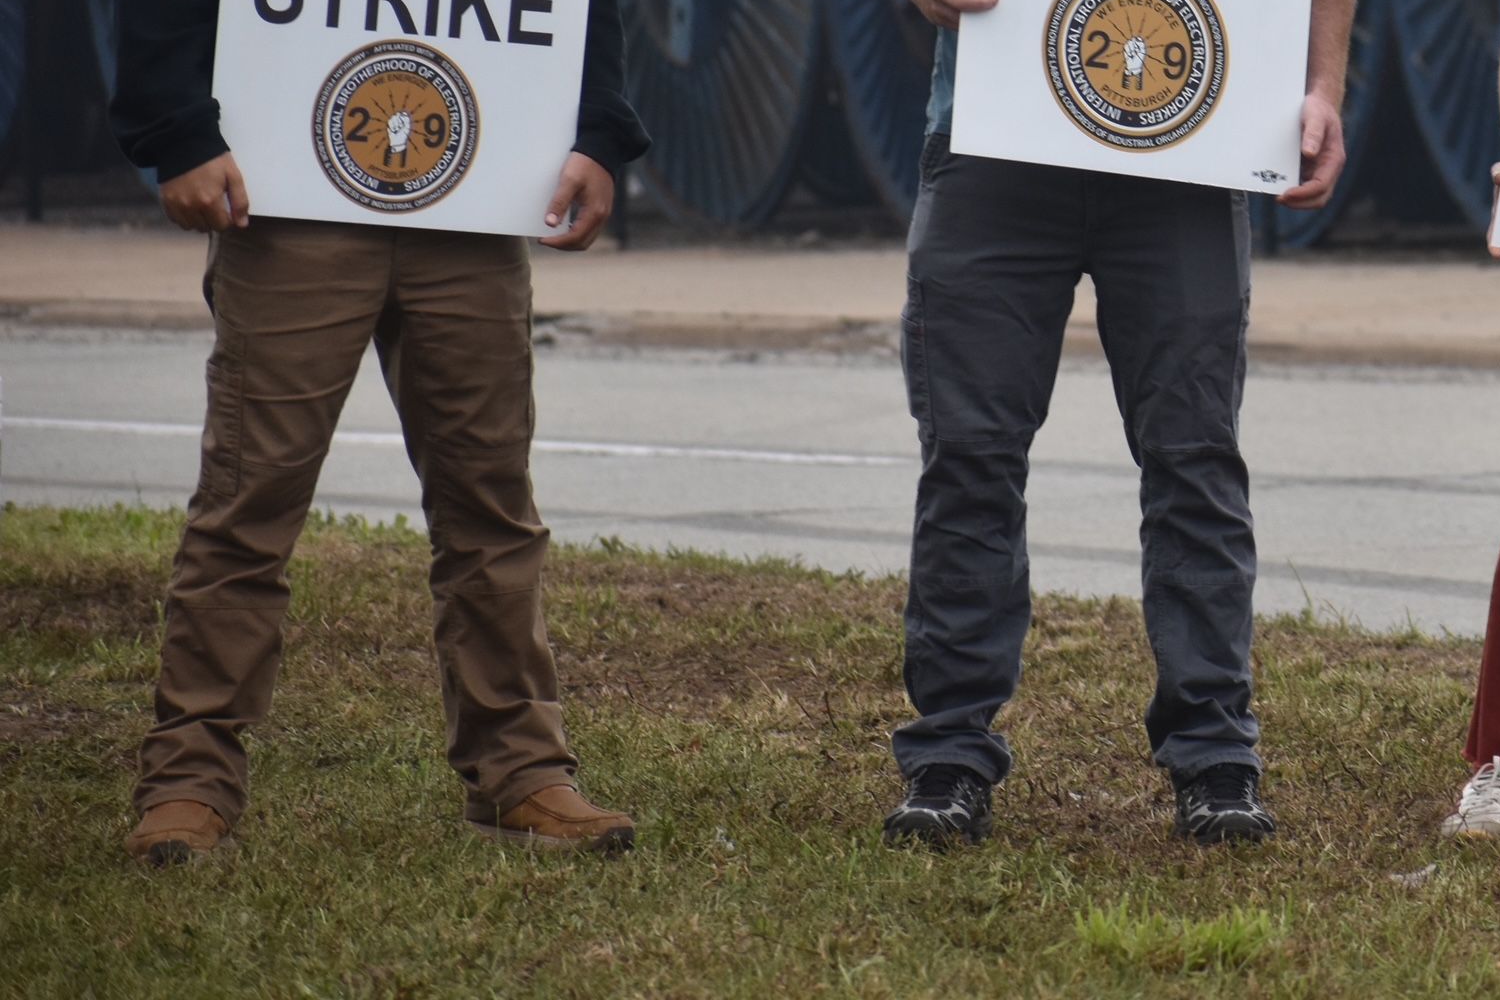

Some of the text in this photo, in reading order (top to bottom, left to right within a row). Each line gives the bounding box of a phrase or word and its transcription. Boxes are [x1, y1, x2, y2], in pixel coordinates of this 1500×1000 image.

[1095, 2, 1114, 20] WE
[1085, 30, 1187, 80] 2 9
[1178, 4, 1204, 87] ELECTRICAL
[336, 60, 417, 106] BROTHERHOOD
[418, 66, 433, 80] OF
[1067, 23, 1121, 122] INTERNATIONAL
[1099, 83, 1172, 107] PITTSBURGH
[431, 76, 459, 149] ELECTRICAL
[1107, 131, 1154, 146] INDUSTRIAL
[1155, 101, 1209, 144] ORGANIZATIONS
[1207, 53, 1222, 97] CANADIAN
[1139, 85, 1195, 125] WORKERS
[332, 106, 379, 190] INTERNATIONAL
[346, 107, 446, 148] 2 9
[404, 149, 454, 192] WORKERS
